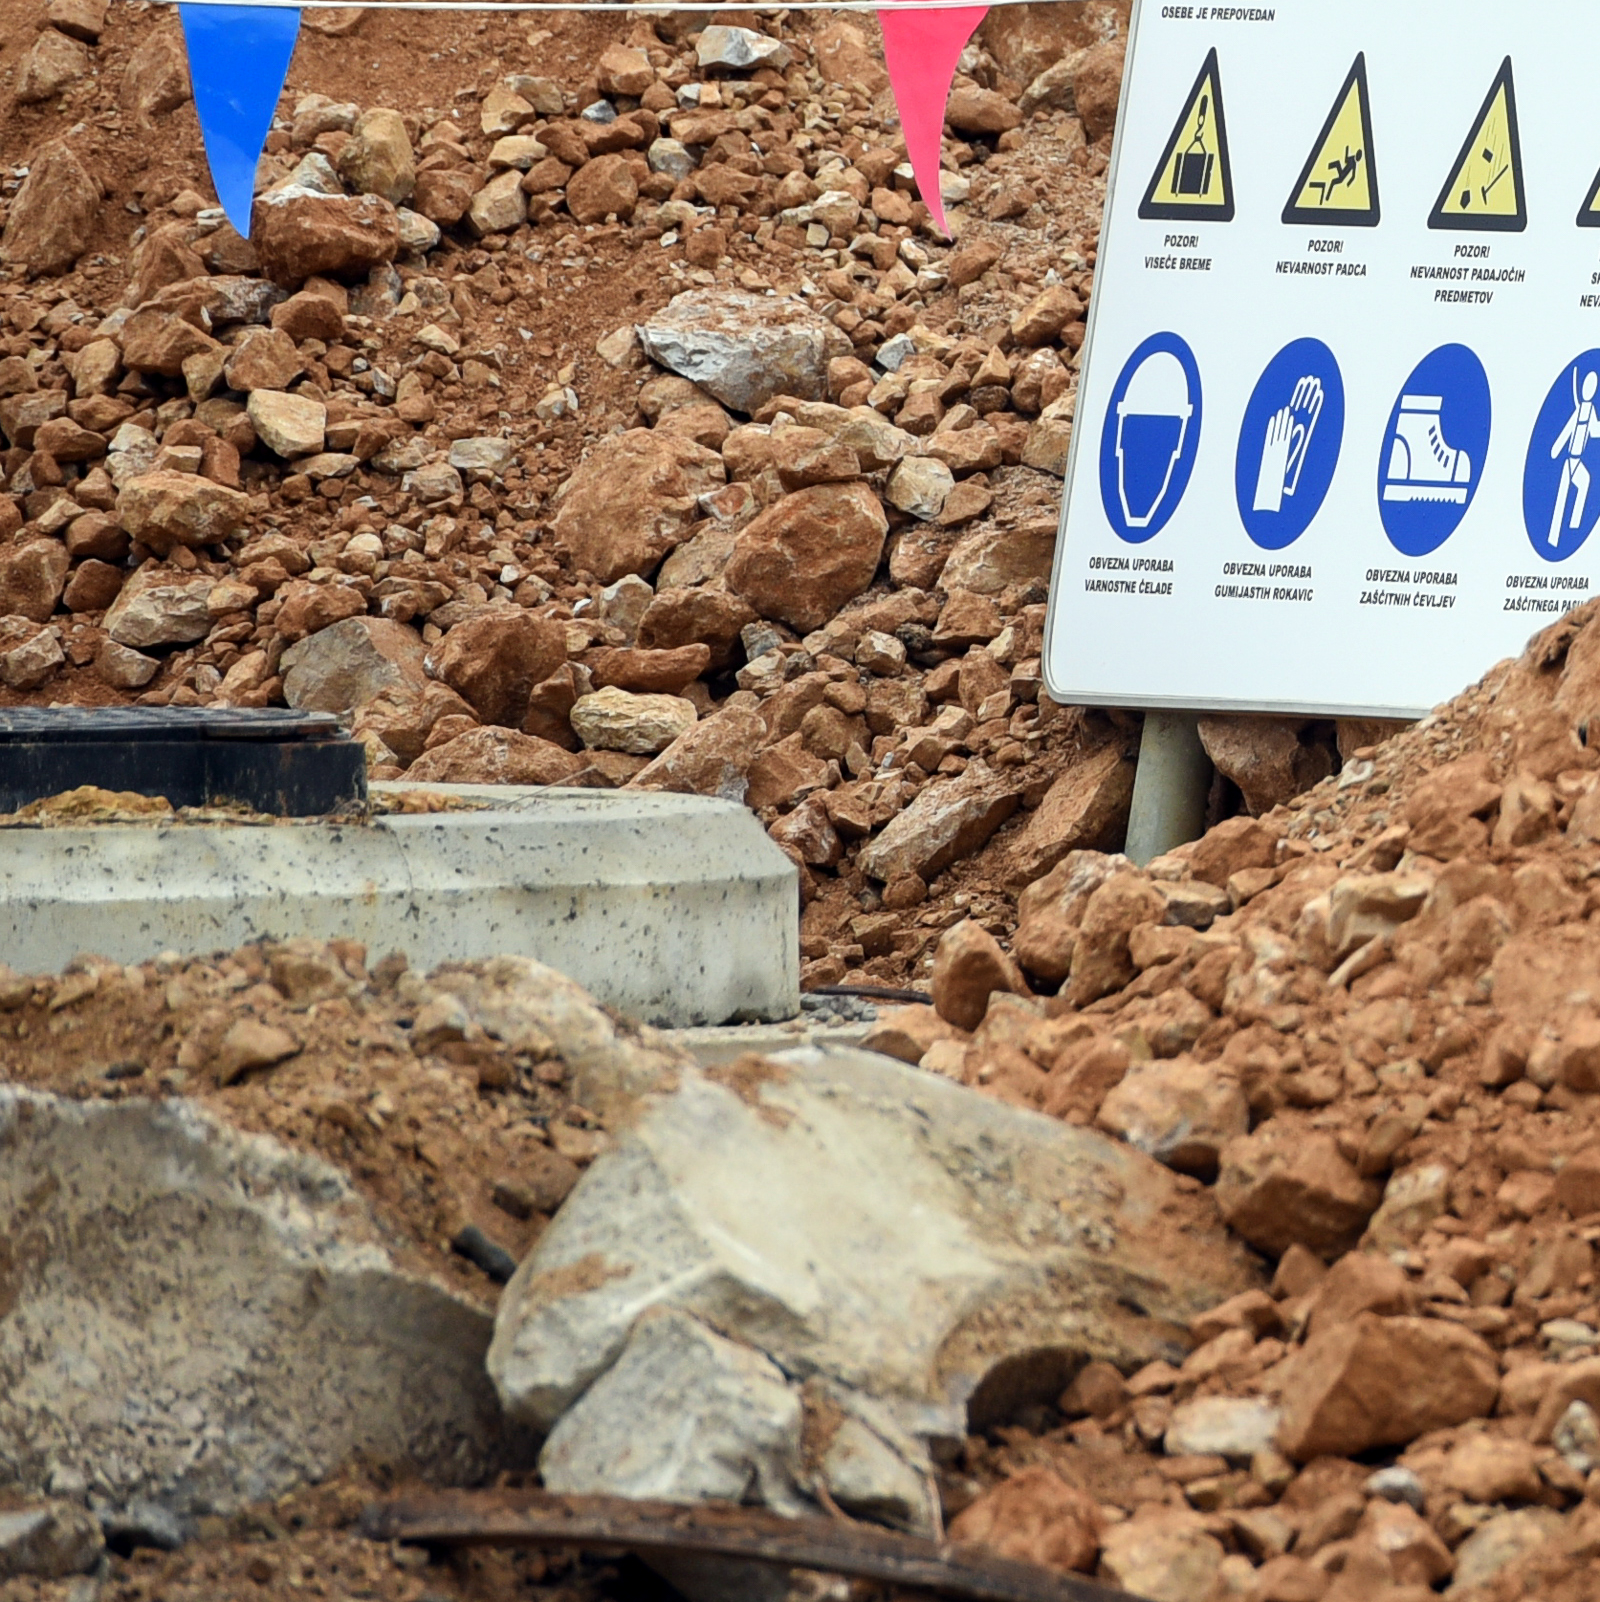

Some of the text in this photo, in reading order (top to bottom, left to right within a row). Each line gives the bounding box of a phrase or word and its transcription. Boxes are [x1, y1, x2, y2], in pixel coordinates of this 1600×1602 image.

[1162, 6, 1275, 21] OSEBE JE PREPOVEDAN
[1164, 235, 1198, 247] POZOR!
[1308, 240, 1343, 252] POZOR!
[1454, 245, 1490, 258] POZOR!
[1145, 254, 1212, 270] VISEČE BREME
[1276, 261, 1366, 276] NEVARNOST PADCA
[1410, 266, 1525, 282] NEVARNOST PADAJOČIH
[1434, 290, 1493, 303] PREDMETOV
[1089, 557, 1173, 572] OBVEZNA UPORABA
[1223, 563, 1311, 578] OBVEZNA UPORABA
[1366, 569, 1457, 585] OBVEZNA UPORABA
[1506, 576, 1588, 589] OBVEZNA UPORABA
[1085, 579, 1172, 595] VARNOSTNE ČELADE
[1215, 585, 1313, 601] GUMIJASTIH ROKAVIC
[1360, 590, 1455, 608] ZAŠČITNIH ČEVLJEV
[1503, 596, 1558, 612] ZAŠČITNEGA
